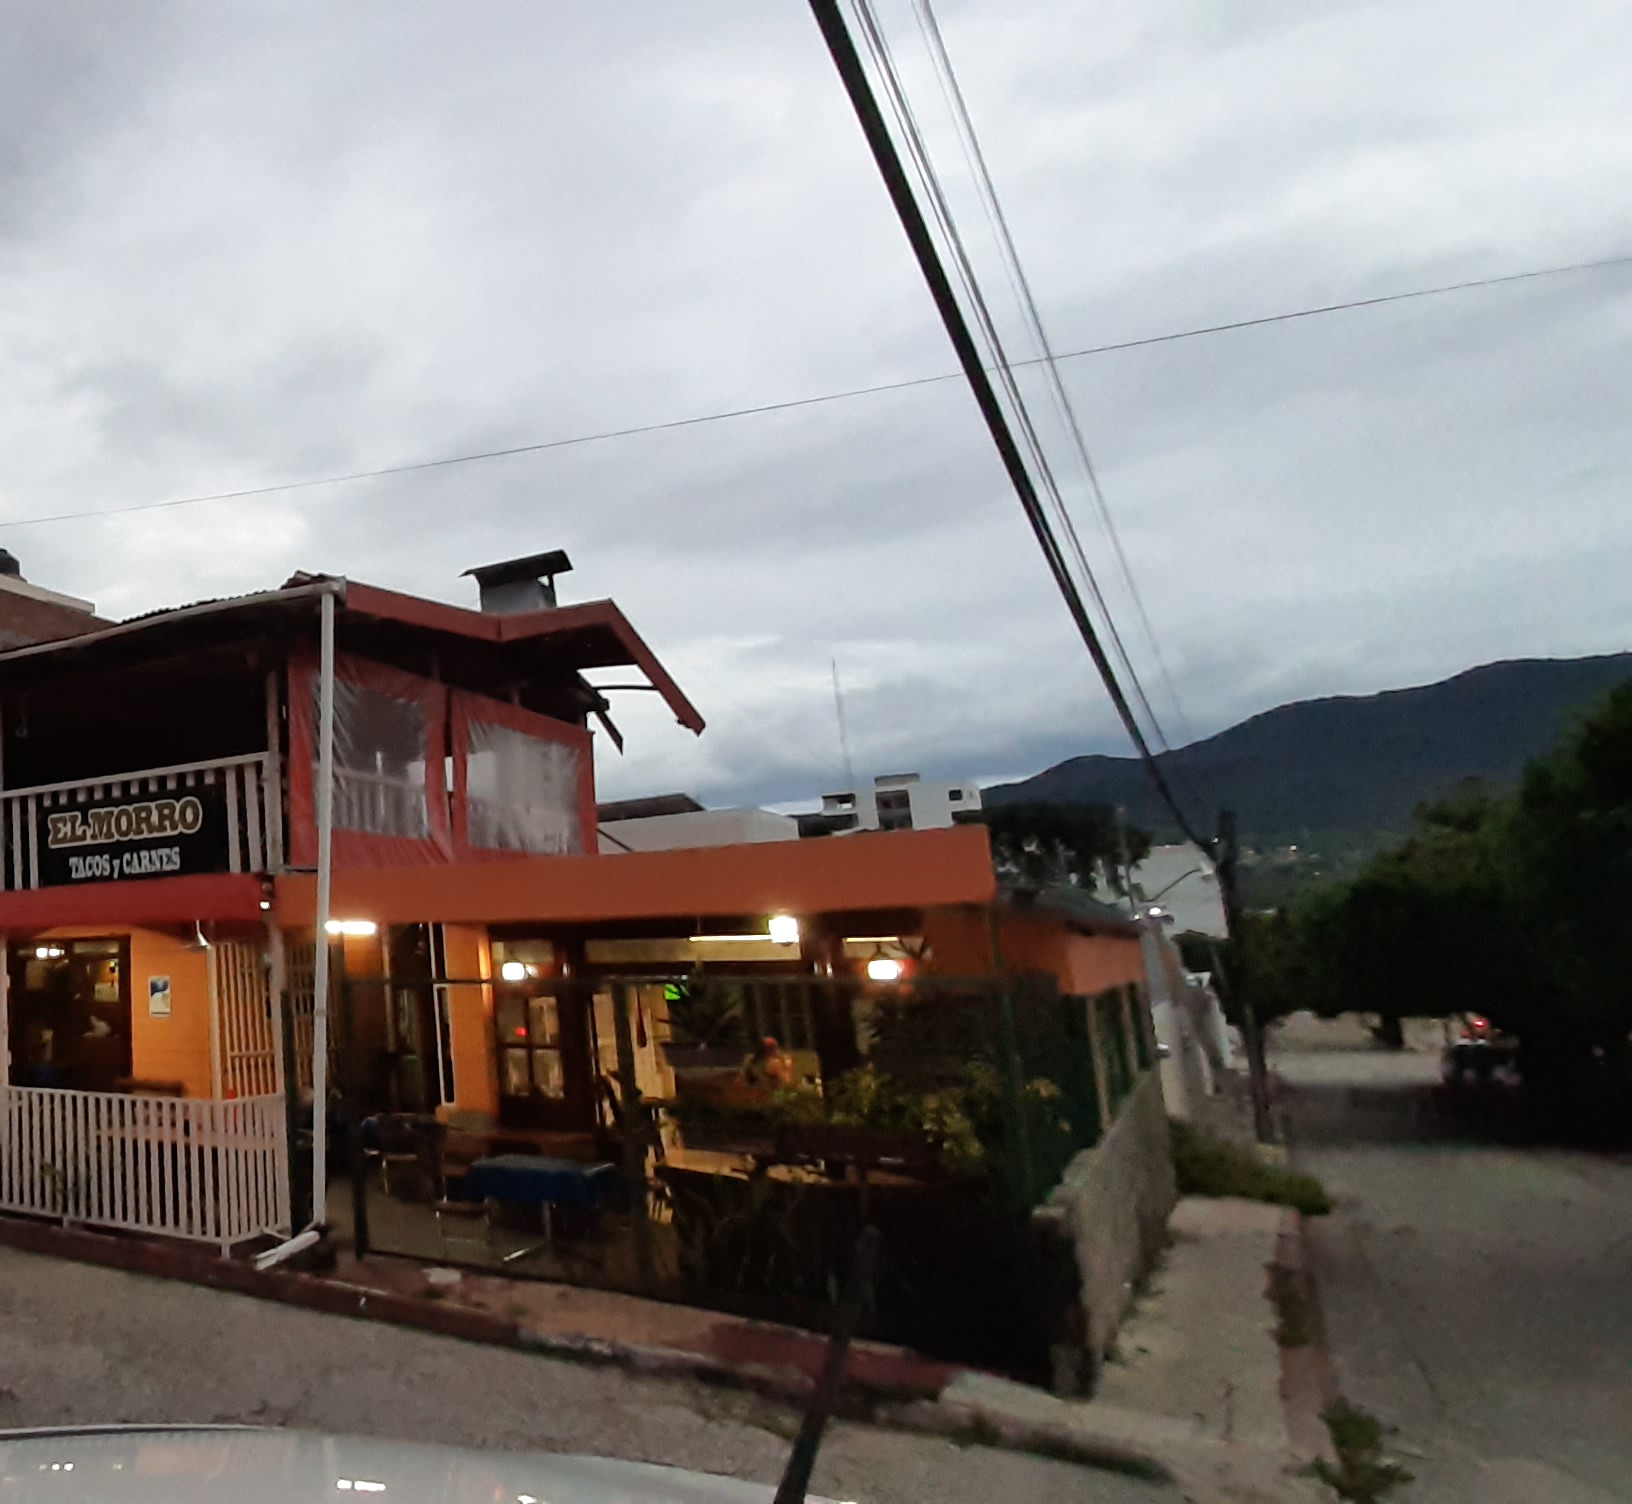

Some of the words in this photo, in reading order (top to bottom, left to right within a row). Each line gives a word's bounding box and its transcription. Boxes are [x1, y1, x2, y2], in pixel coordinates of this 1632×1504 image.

[48, 811, 88, 848] EL
[88, 796, 202, 842] MORRO
[69, 853, 111, 879] TACOS
[123, 847, 181, 875] CARNES
